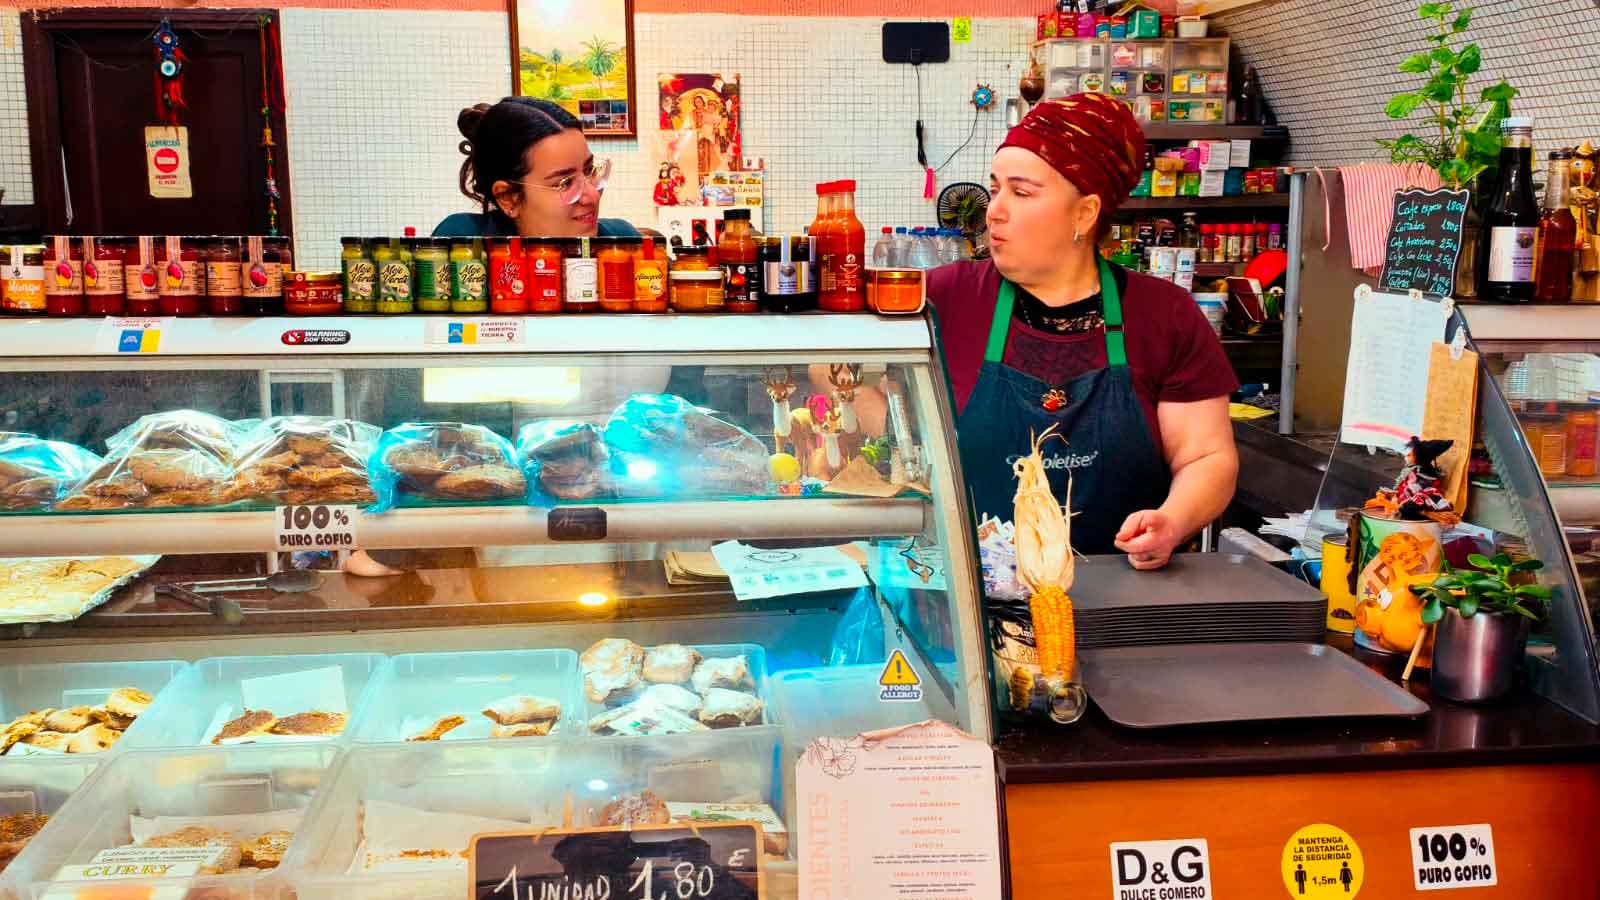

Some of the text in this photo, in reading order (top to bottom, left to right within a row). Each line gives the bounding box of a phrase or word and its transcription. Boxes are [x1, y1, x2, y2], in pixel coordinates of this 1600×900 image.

[279, 532, 353, 546] PURO GOFIO
[881, 690, 920, 699] ALLERGY
[1298, 836, 1344, 845] MANTENGA
[1294, 844, 1350, 854] LA DISTANCIA
[1293, 853, 1352, 862] DE SEGURIDAD
[1418, 864, 1492, 884] PURO GOFIO
[1121, 886, 1205, 900] DULCE GOMERO
